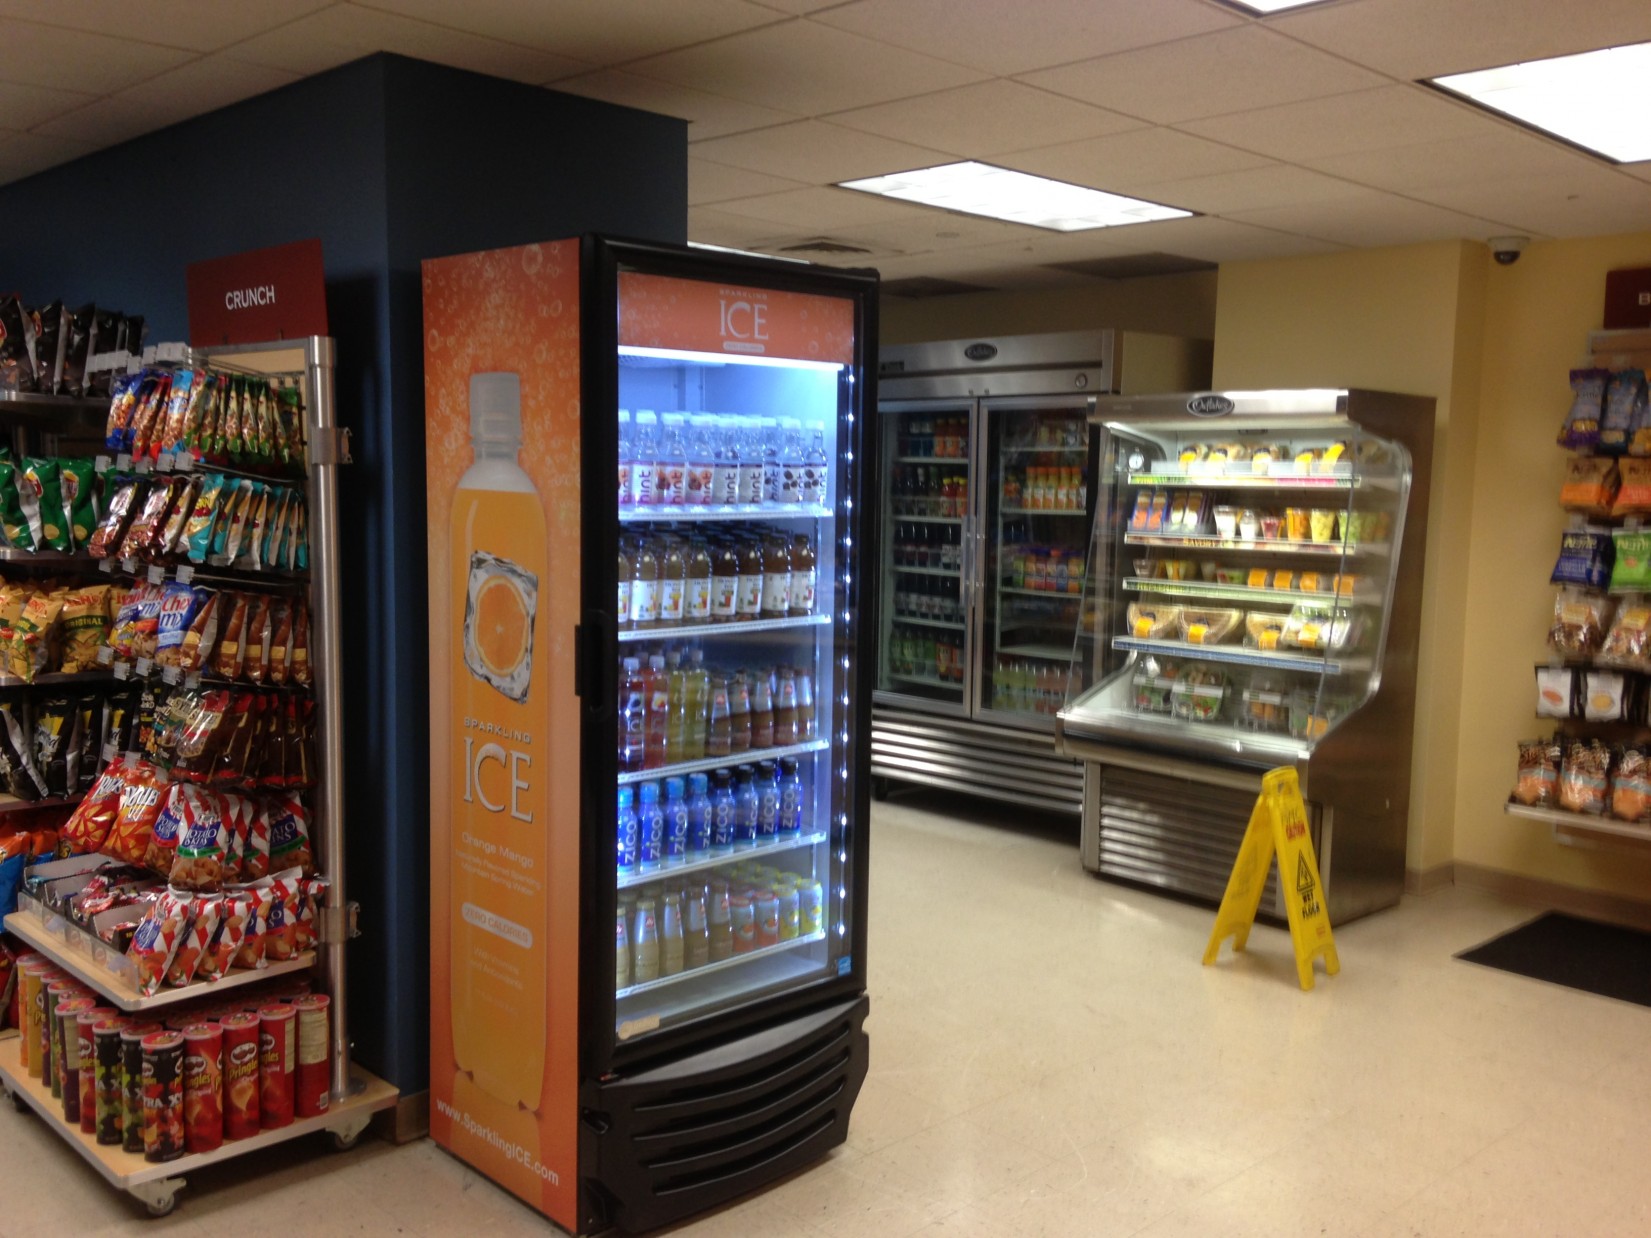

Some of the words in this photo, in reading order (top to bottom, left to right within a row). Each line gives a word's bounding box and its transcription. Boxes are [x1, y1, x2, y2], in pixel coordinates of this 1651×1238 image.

[225, 284, 275, 310] CRUNCH
[719, 288, 768, 300] SPARKLING
[719, 299, 769, 340] ICE
[725, 472, 737, 504] hint
[749, 472, 761, 503] hint
[162, 595, 192, 612] Chex
[464, 716, 532, 744] SPARKLING
[463, 736, 534, 824] ICE
[716, 803, 728, 844] ZICO
[763, 793, 775, 833] ZICO
[783, 789, 795, 828] ZICO
[183, 836, 208, 847] SKINS
[186, 828, 218, 839] POTATO
[462, 831, 497, 854] Orange
[499, 845, 534, 869] Mango
[625, 820, 636, 864] ZICO
[650, 816, 662, 859] ZICO
[674, 811, 686, 853] ZICO
[465, 907, 487, 924] ZERO
[488, 916, 529, 944] CALORIES
[228, 1059, 258, 1081] Pringle
[436, 1099, 560, 1186] www.SparklingICE.com
